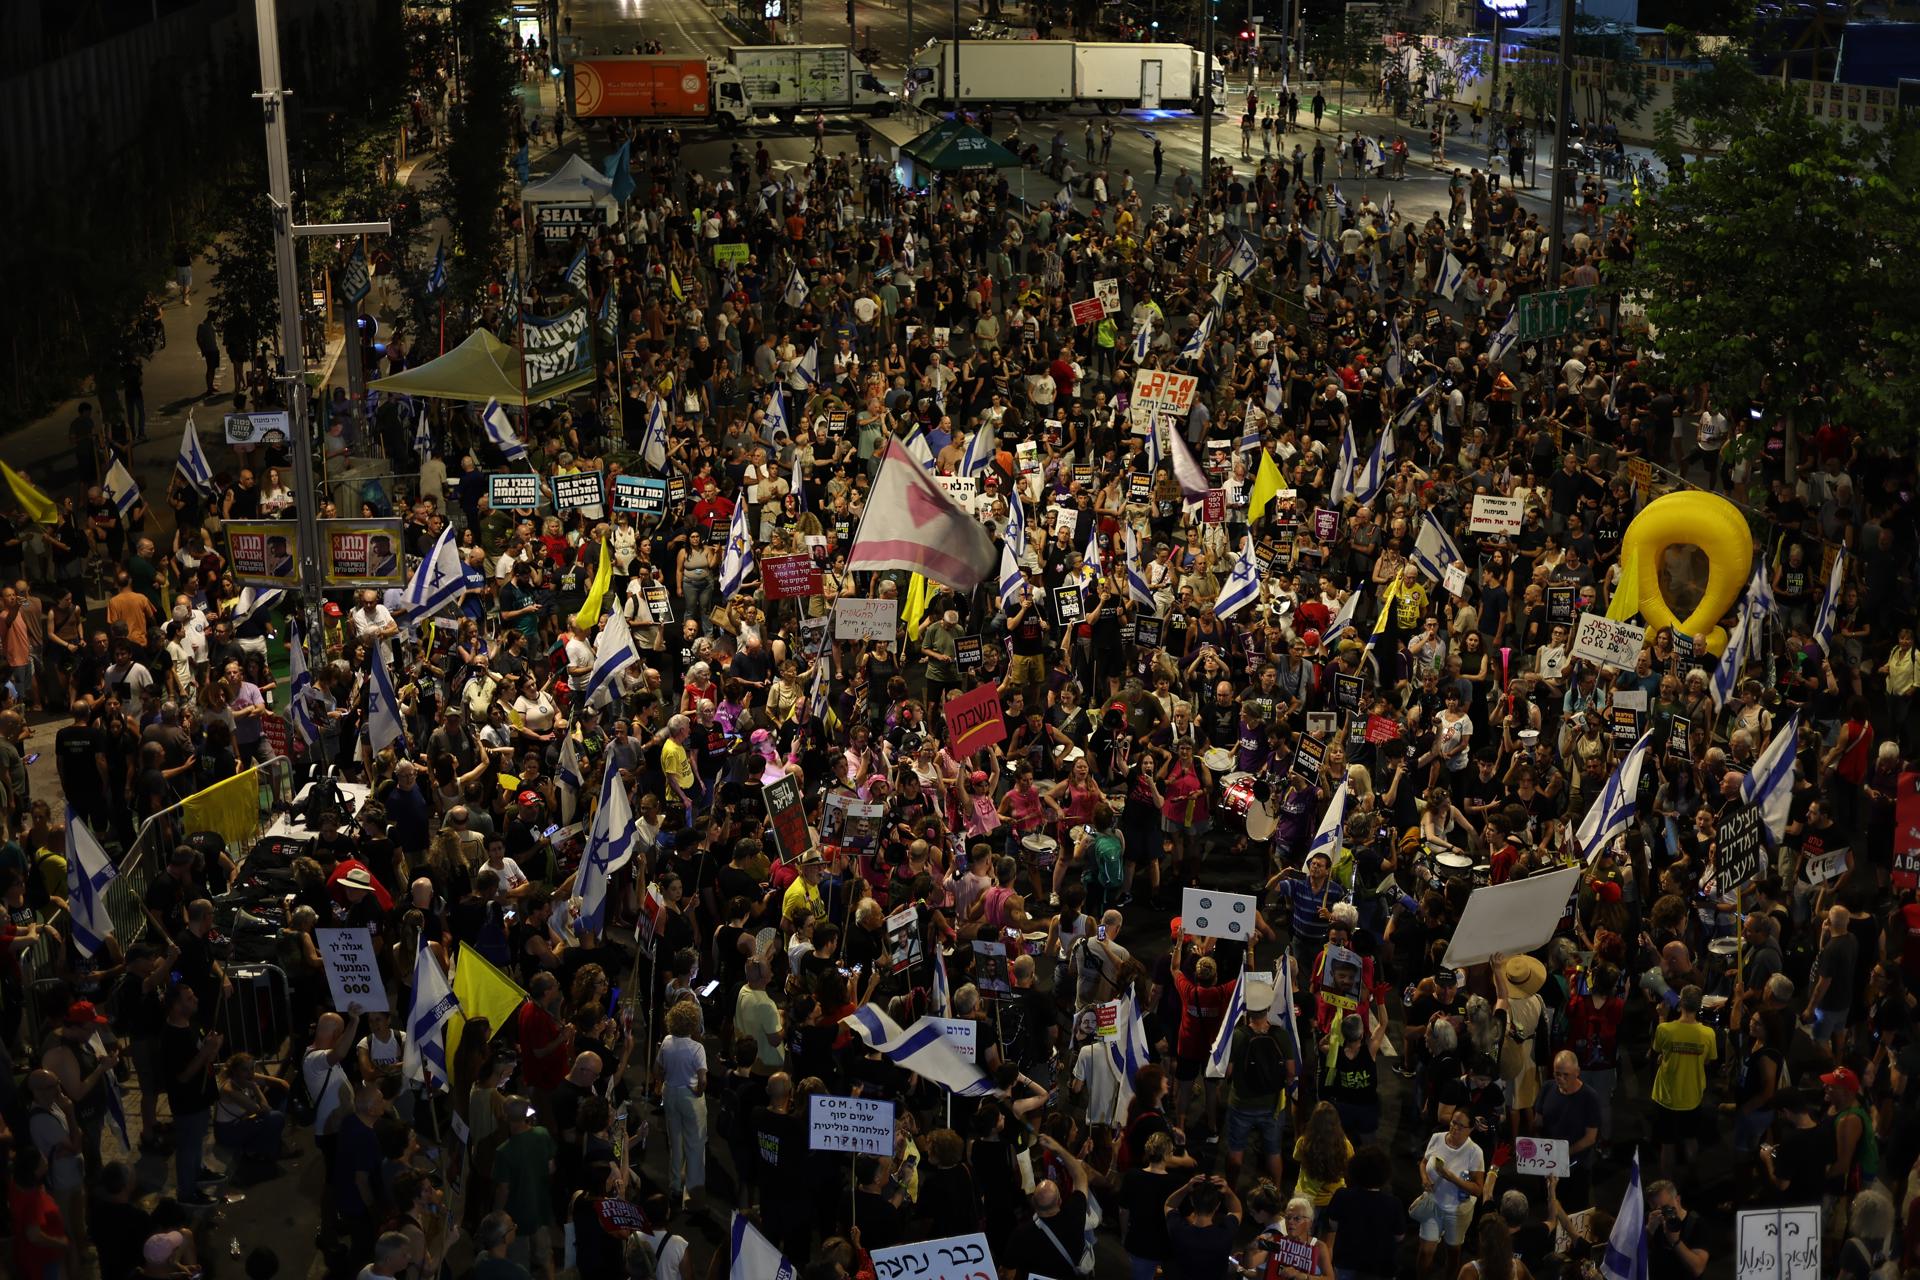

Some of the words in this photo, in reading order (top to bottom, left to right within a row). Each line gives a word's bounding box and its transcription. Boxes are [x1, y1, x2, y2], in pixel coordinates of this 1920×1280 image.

[541, 208, 584, 222] SEAL
[544, 226, 567, 238] THE
[494, 478, 509, 487] את
[511, 478, 535, 487] עצרו
[557, 479, 571, 489] את
[572, 477, 597, 487] לסיים
[950, 479, 961, 490] לא
[963, 483, 974, 491] זה
[494, 487, 535, 497] המלחמה
[558, 485, 598, 497] המלחמה
[617, 485, 632, 495] עוד
[633, 487, 645, 496] דם
[645, 488, 663, 498] כמה
[560, 494, 600, 508] עכשיו!
[620, 496, 658, 509] יישפך?
[1481, 498, 1507, 506] שמשחרר
[1599, 530, 1619, 540] 7.10
[240, 536, 261, 550] מתן
[341, 536, 363, 550] מתן
[234, 550, 263, 560] אנגרסט
[335, 550, 364, 560] אנגרסט
[1594, 636, 1604, 648] של
[1610, 633, 1629, 645] מוסר
[1607, 642, 1620, 653] שם
[952, 699, 998, 736] תשבתו
[1736, 806, 1757, 833] תציל
[1719, 819, 1736, 844] את
[1721, 827, 1758, 865] המדינה
[1895, 854, 1903, 868] A
[1719, 853, 1755, 896] מעצמך
[338, 932, 353, 941] גלי,
[329, 943, 340, 953] לך
[340, 954, 358, 963] קוד
[334, 962, 370, 972] המנעול
[358, 974, 371, 982] של
[946, 1025, 971, 1036] סדום
[830, 1111, 847, 1121] סוף
[850, 1113, 874, 1122] שמים
[814, 1122, 849, 1131] פוליטית
[852, 1125, 890, 1137] למלחמה
[824, 1135, 880, 1149] ומופקרת
[1540, 1143, 1553, 1156] די
[1764, 1223, 1778, 1237] בי
[1784, 1221, 1799, 1236] בי
[1280, 1237, 1313, 1259] ממשלת
[938, 1244, 984, 1266] כבר
[875, 1252, 929, 1279] נחצה
[1275, 1250, 1313, 1274] ההפקרה
